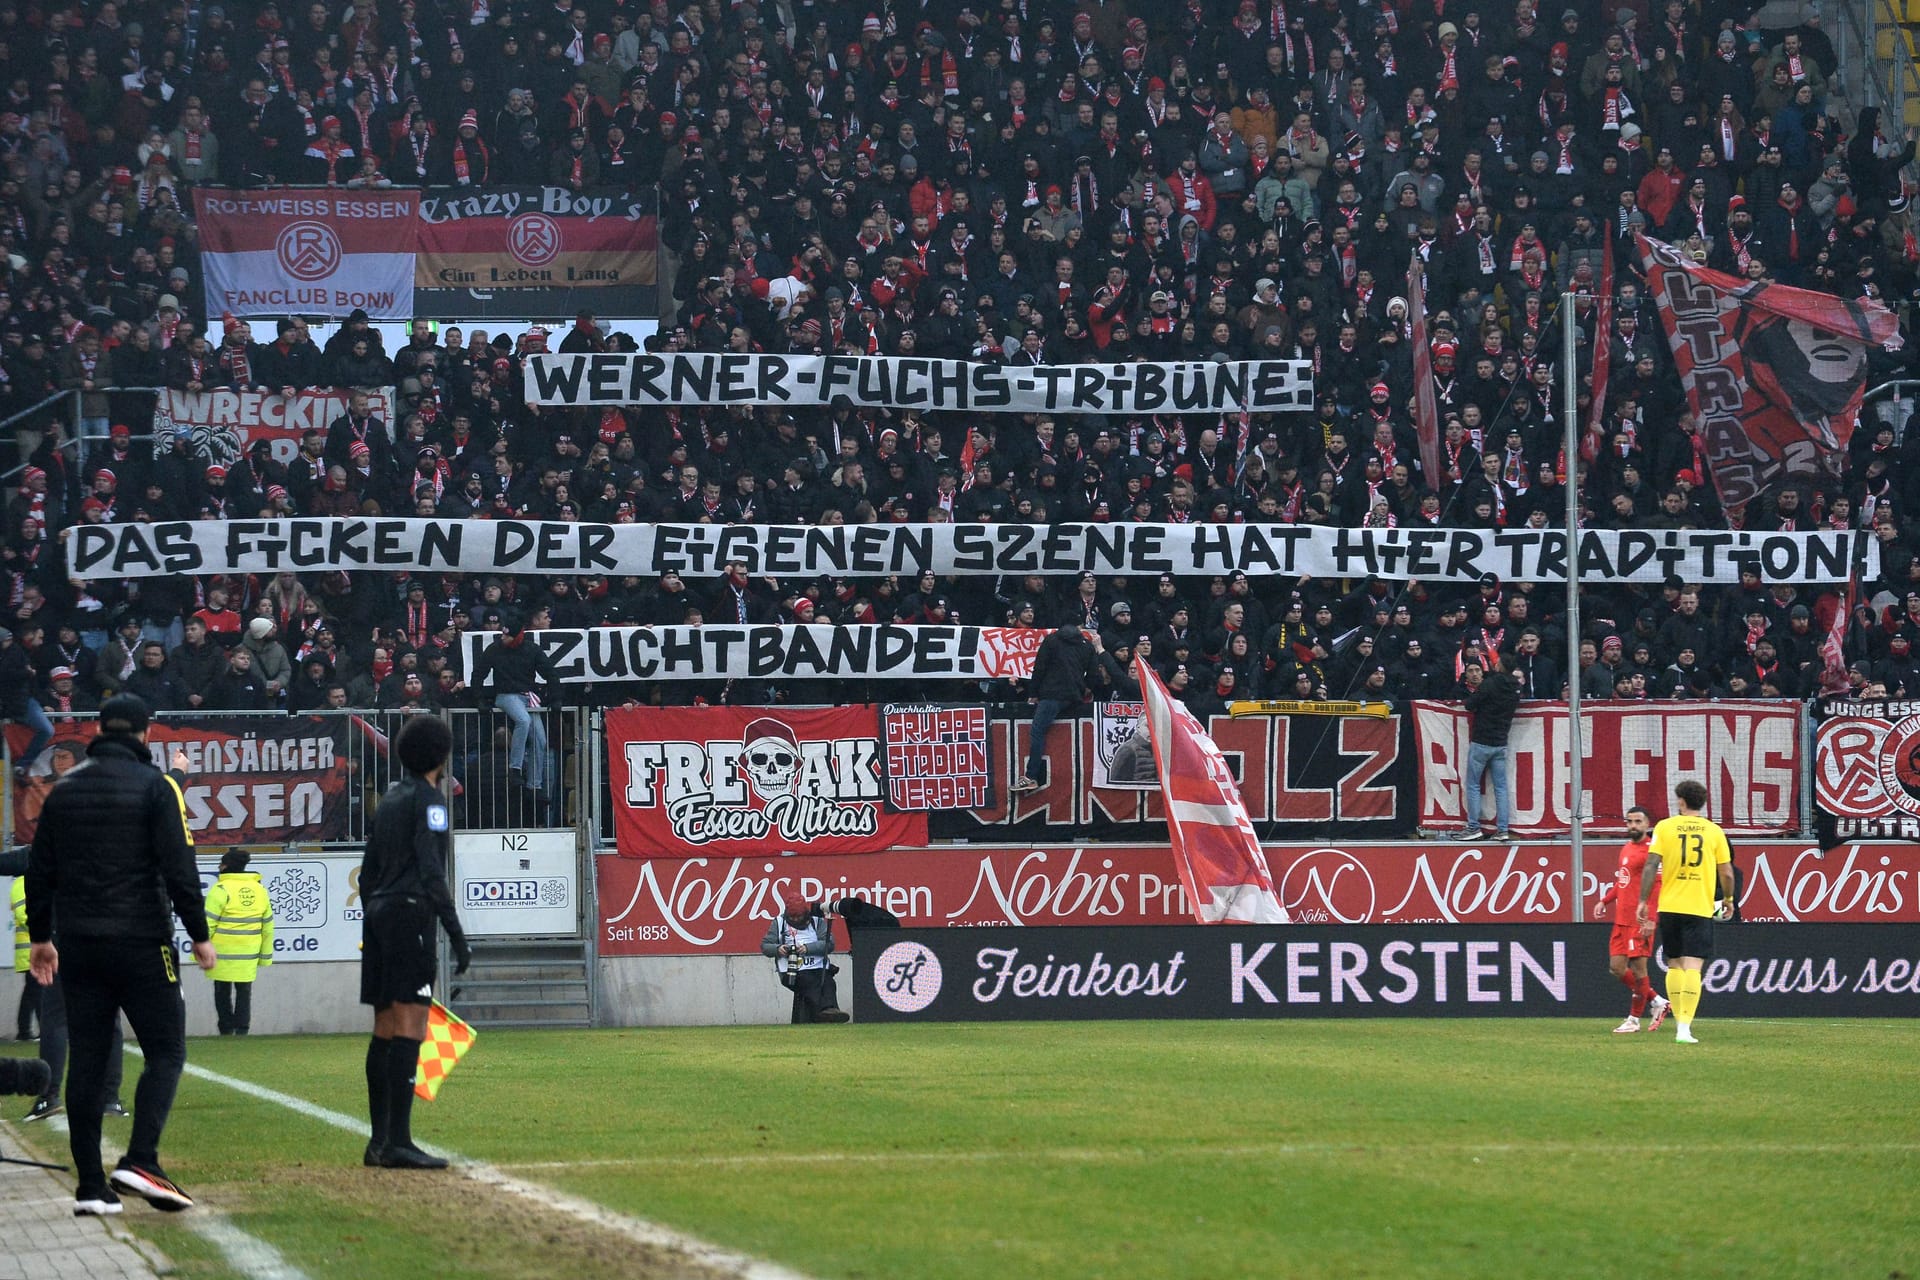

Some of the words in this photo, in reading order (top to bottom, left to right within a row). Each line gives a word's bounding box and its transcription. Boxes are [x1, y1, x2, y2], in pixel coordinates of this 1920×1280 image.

[205, 198, 329, 217] ROT-WEISS
[336, 201, 410, 219] ESSEN
[490, 266, 552, 283] Leben
[567, 266, 620, 283] Lang
[224, 288, 328, 306] FANCLUB
[335, 290, 395, 309] BONN
[74, 521, 203, 573] DAS
[493, 520, 619, 570] DER
[953, 525, 1173, 573] SZENE
[1191, 525, 1312, 573] HAT
[472, 625, 980, 686] IZUCHTBANDE!
[885, 708, 986, 744] GRUPPE
[1824, 701, 1884, 717] JUNGE
[887, 741, 987, 778] STADION
[1416, 708, 1594, 826] RDE
[1620, 714, 1795, 826] FANS
[184, 781, 324, 830] SSEN
[889, 774, 988, 811] VERBOT
[670, 794, 769, 843] Essen
[766, 795, 877, 842] Ultras
[1836, 817, 1920, 839] ULTR
[502, 834, 529, 852] N2
[1678, 833, 1704, 868] 13
[468, 882, 537, 900] DORR
[605, 857, 791, 946] Nobis
[945, 849, 1130, 926] Nobis
[1382, 846, 1566, 923] Nobis
[1738, 845, 1909, 922] Nobis
[344, 910, 364, 920] DO
[607, 927, 634, 941] Seit
[637, 925, 669, 940] 1858
[973, 947, 1188, 1003] Feinkost
[1230, 940, 1567, 1004] KERSTEN
